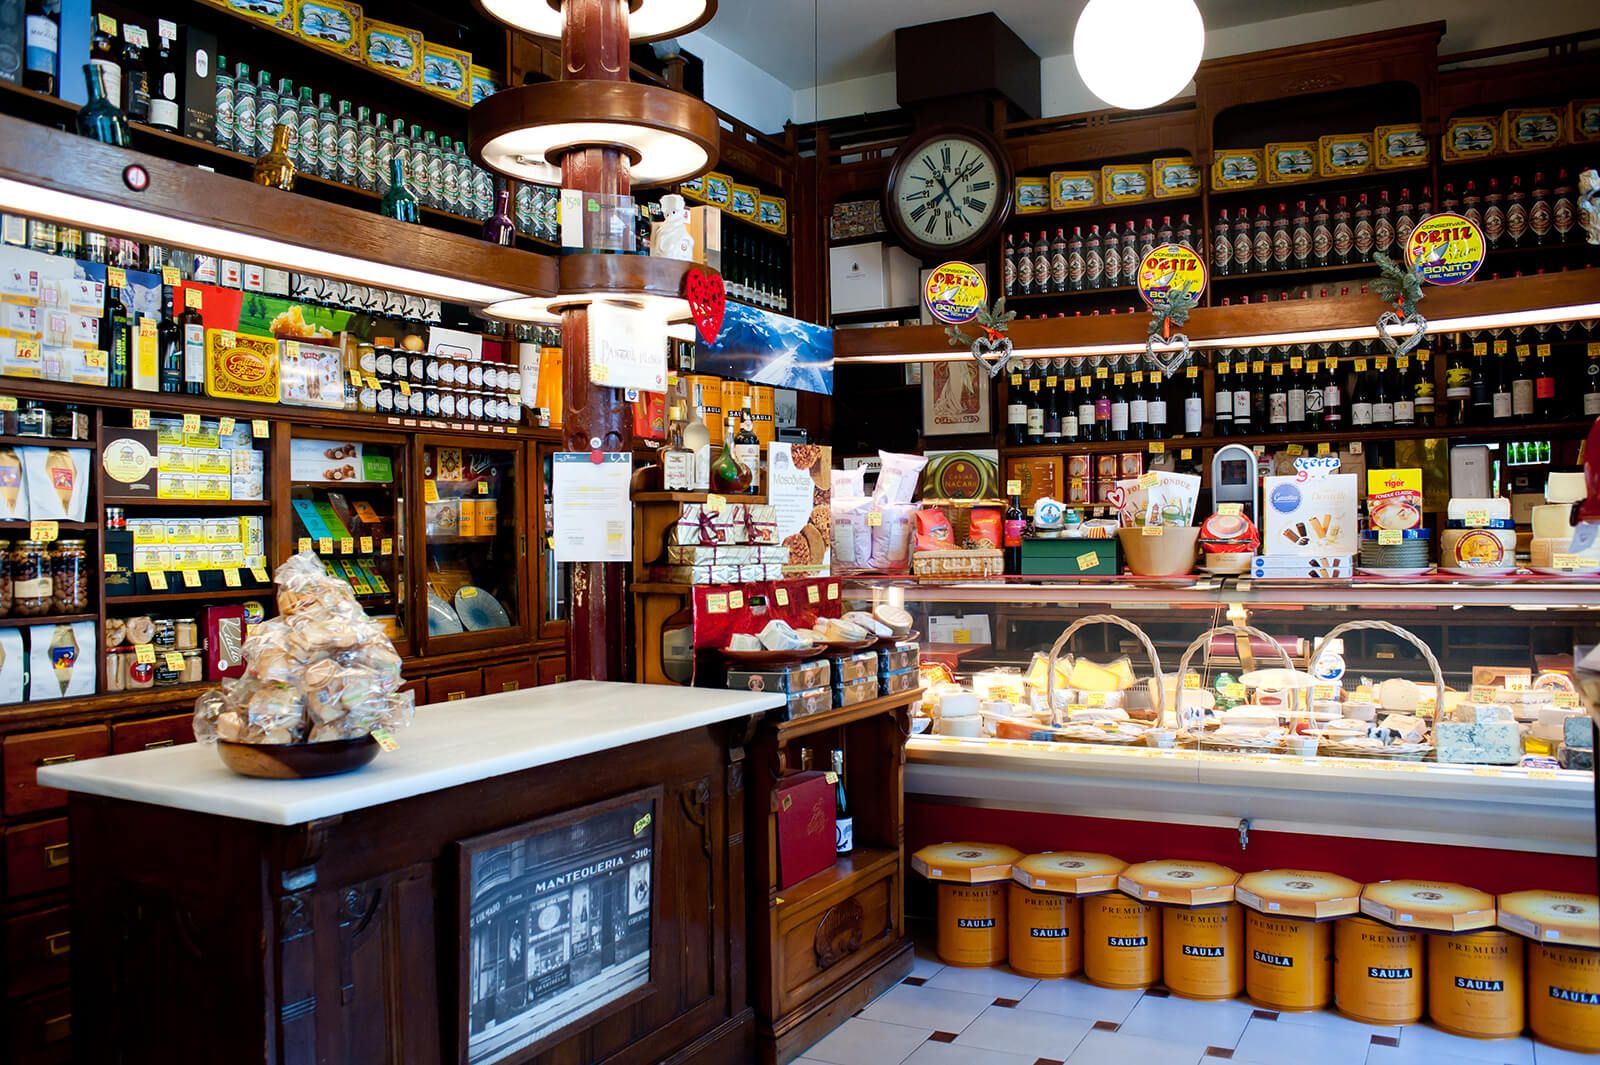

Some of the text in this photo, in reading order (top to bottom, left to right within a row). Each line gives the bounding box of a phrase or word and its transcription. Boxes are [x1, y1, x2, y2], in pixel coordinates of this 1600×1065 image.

[1415, 226, 1473, 244] ORTIZ
[1146, 257, 1197, 271] ORTIZ
[1423, 263, 1472, 274] BONITO
[933, 272, 979, 288] ORTIZ
[1149, 290, 1192, 299] BOO
[935, 303, 974, 313] BONITO
[17, 349, 31, 358] 16
[1101, 905, 1152, 914] PREMIUM
[959, 918, 993, 928] SAULA
[1176, 912, 1229, 923] PREMIUM
[1032, 928, 1067, 937] SAULA
[1361, 932, 1417, 943] PREMIUM
[1109, 936, 1146, 946] SAULA
[1184, 945, 1222, 957] SAULA
[1447, 941, 1509, 954] PREMIUM
[1254, 951, 1291, 967] SAULA
[1370, 968, 1411, 978] SAULA
[1457, 977, 1502, 991] SAULA
[1551, 986, 1600, 1004] SAULA
